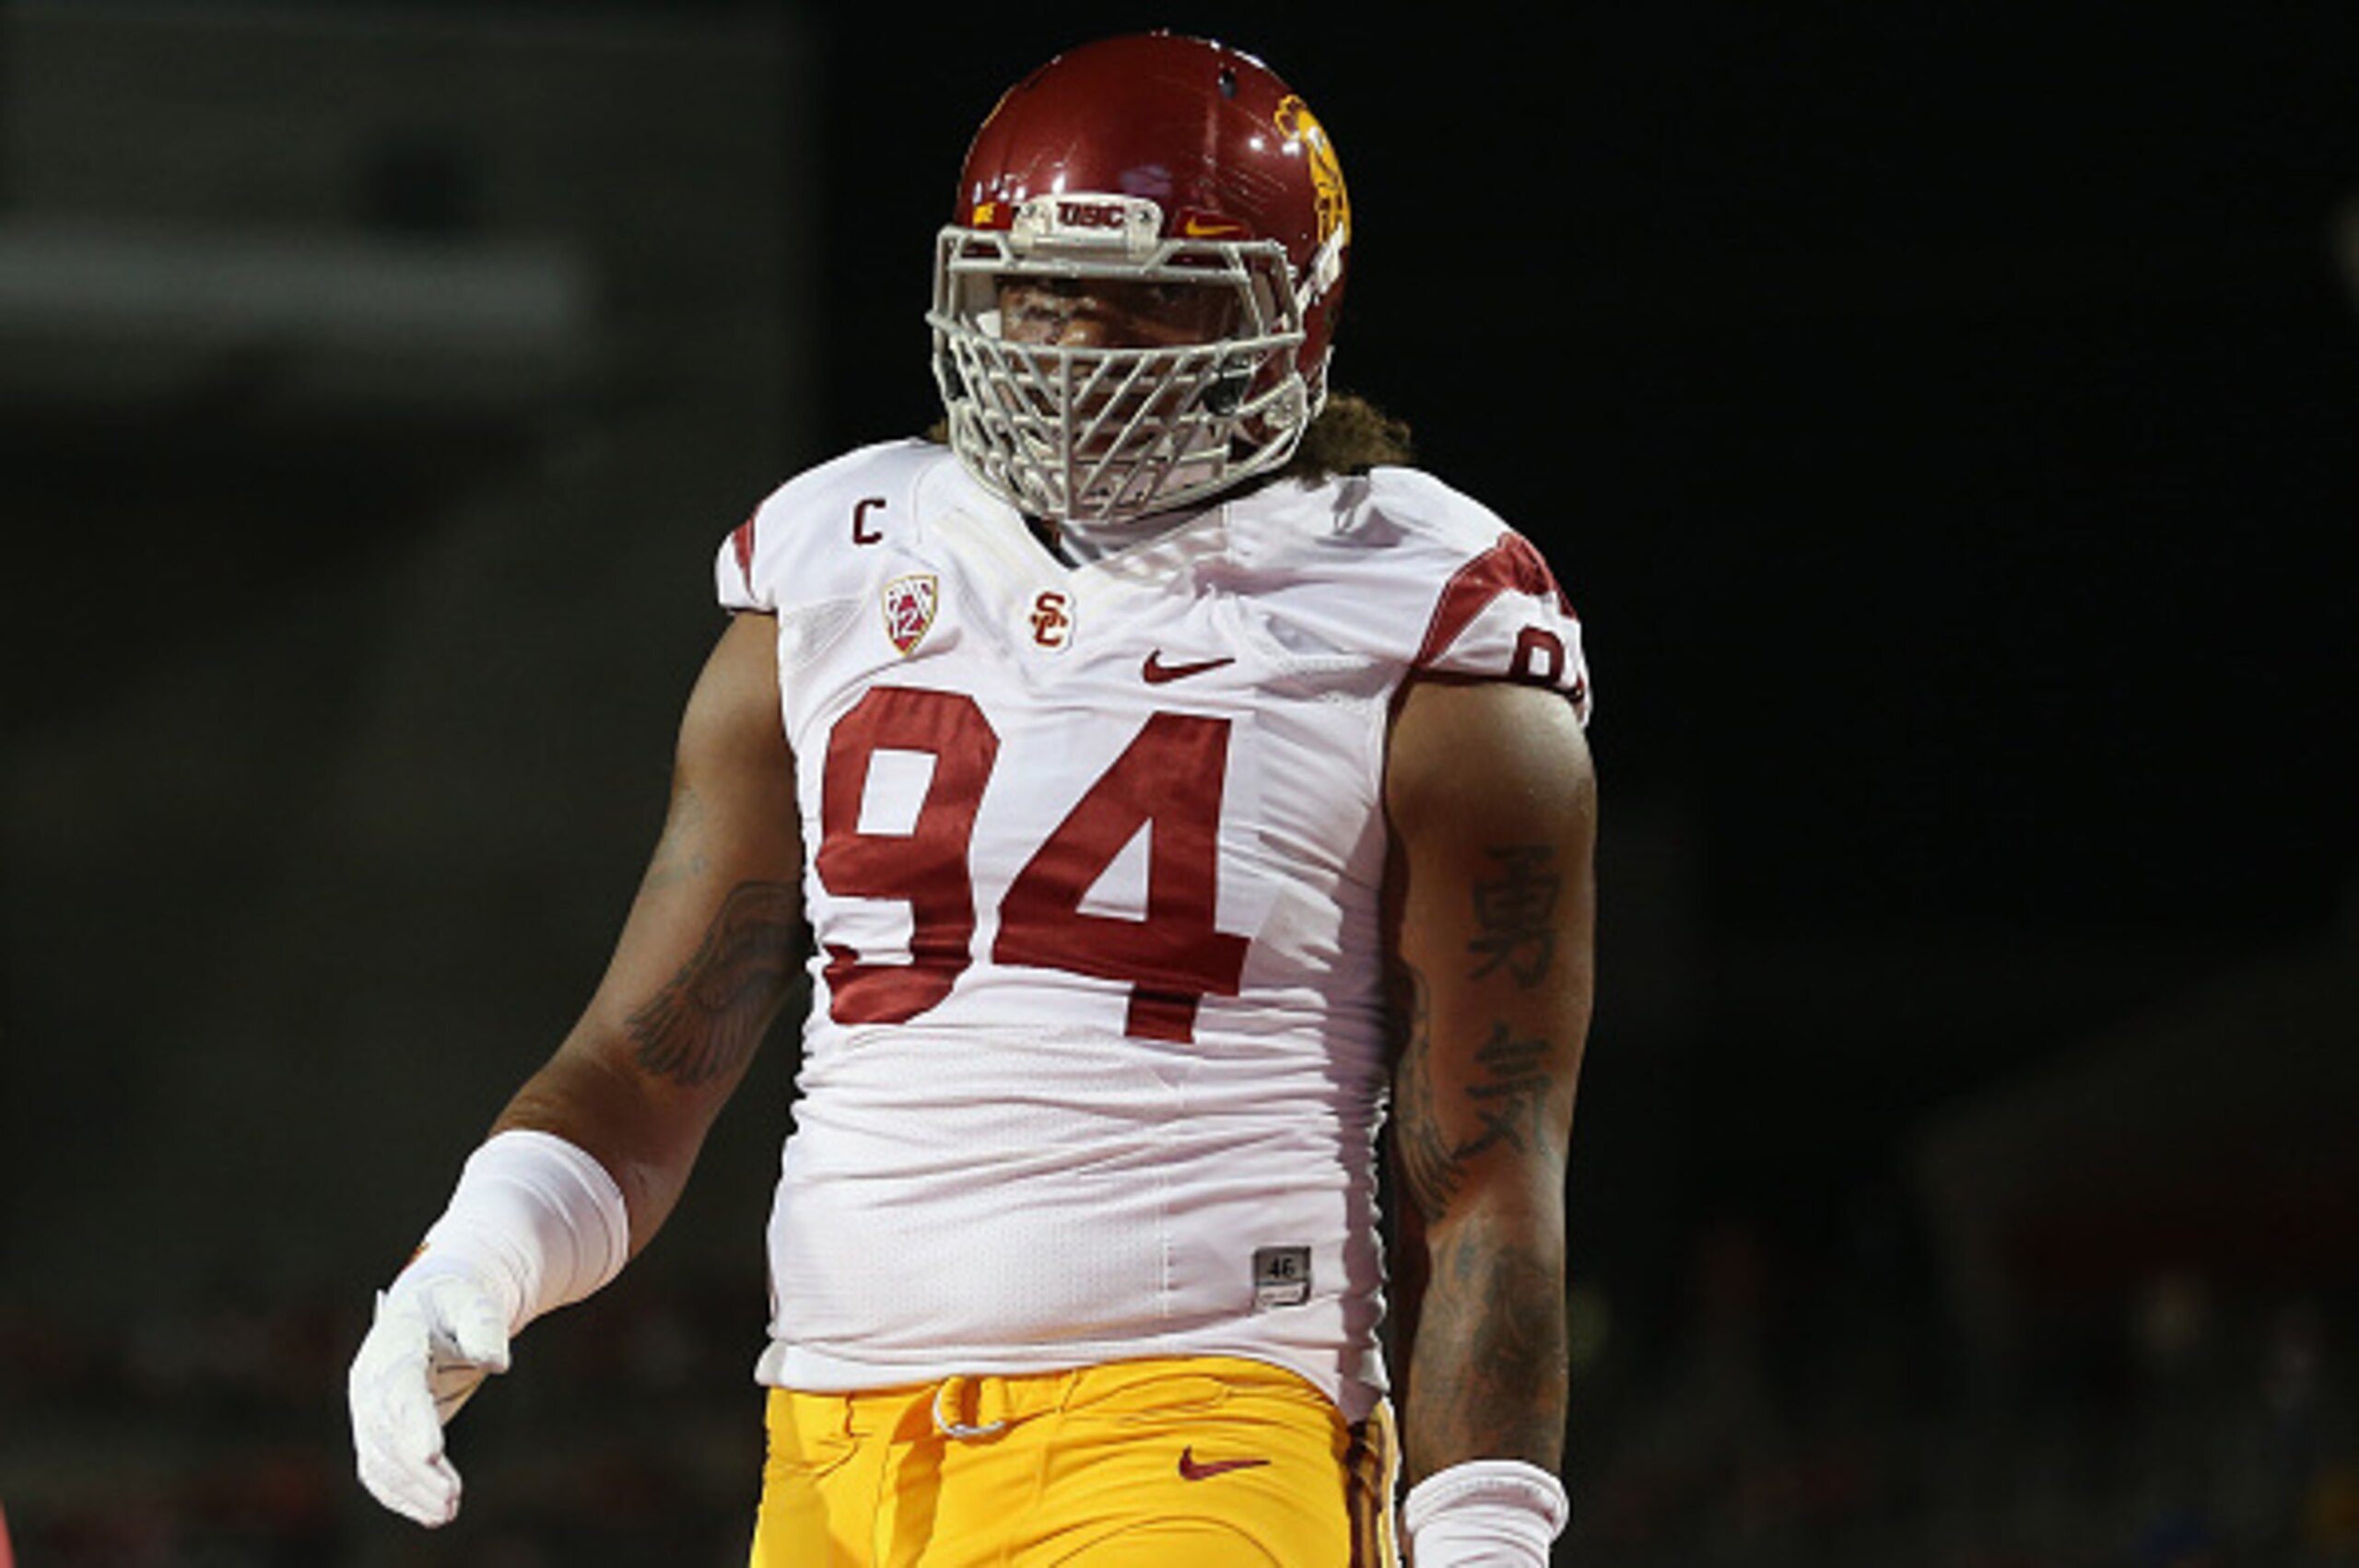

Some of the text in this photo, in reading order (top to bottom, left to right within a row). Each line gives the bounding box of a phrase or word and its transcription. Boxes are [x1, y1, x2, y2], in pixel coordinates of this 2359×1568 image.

[1057, 202, 1125, 227] USC
[851, 497, 886, 545] C
[814, 685, 1251, 1045] 94
[1266, 1256, 1297, 1280] 46
